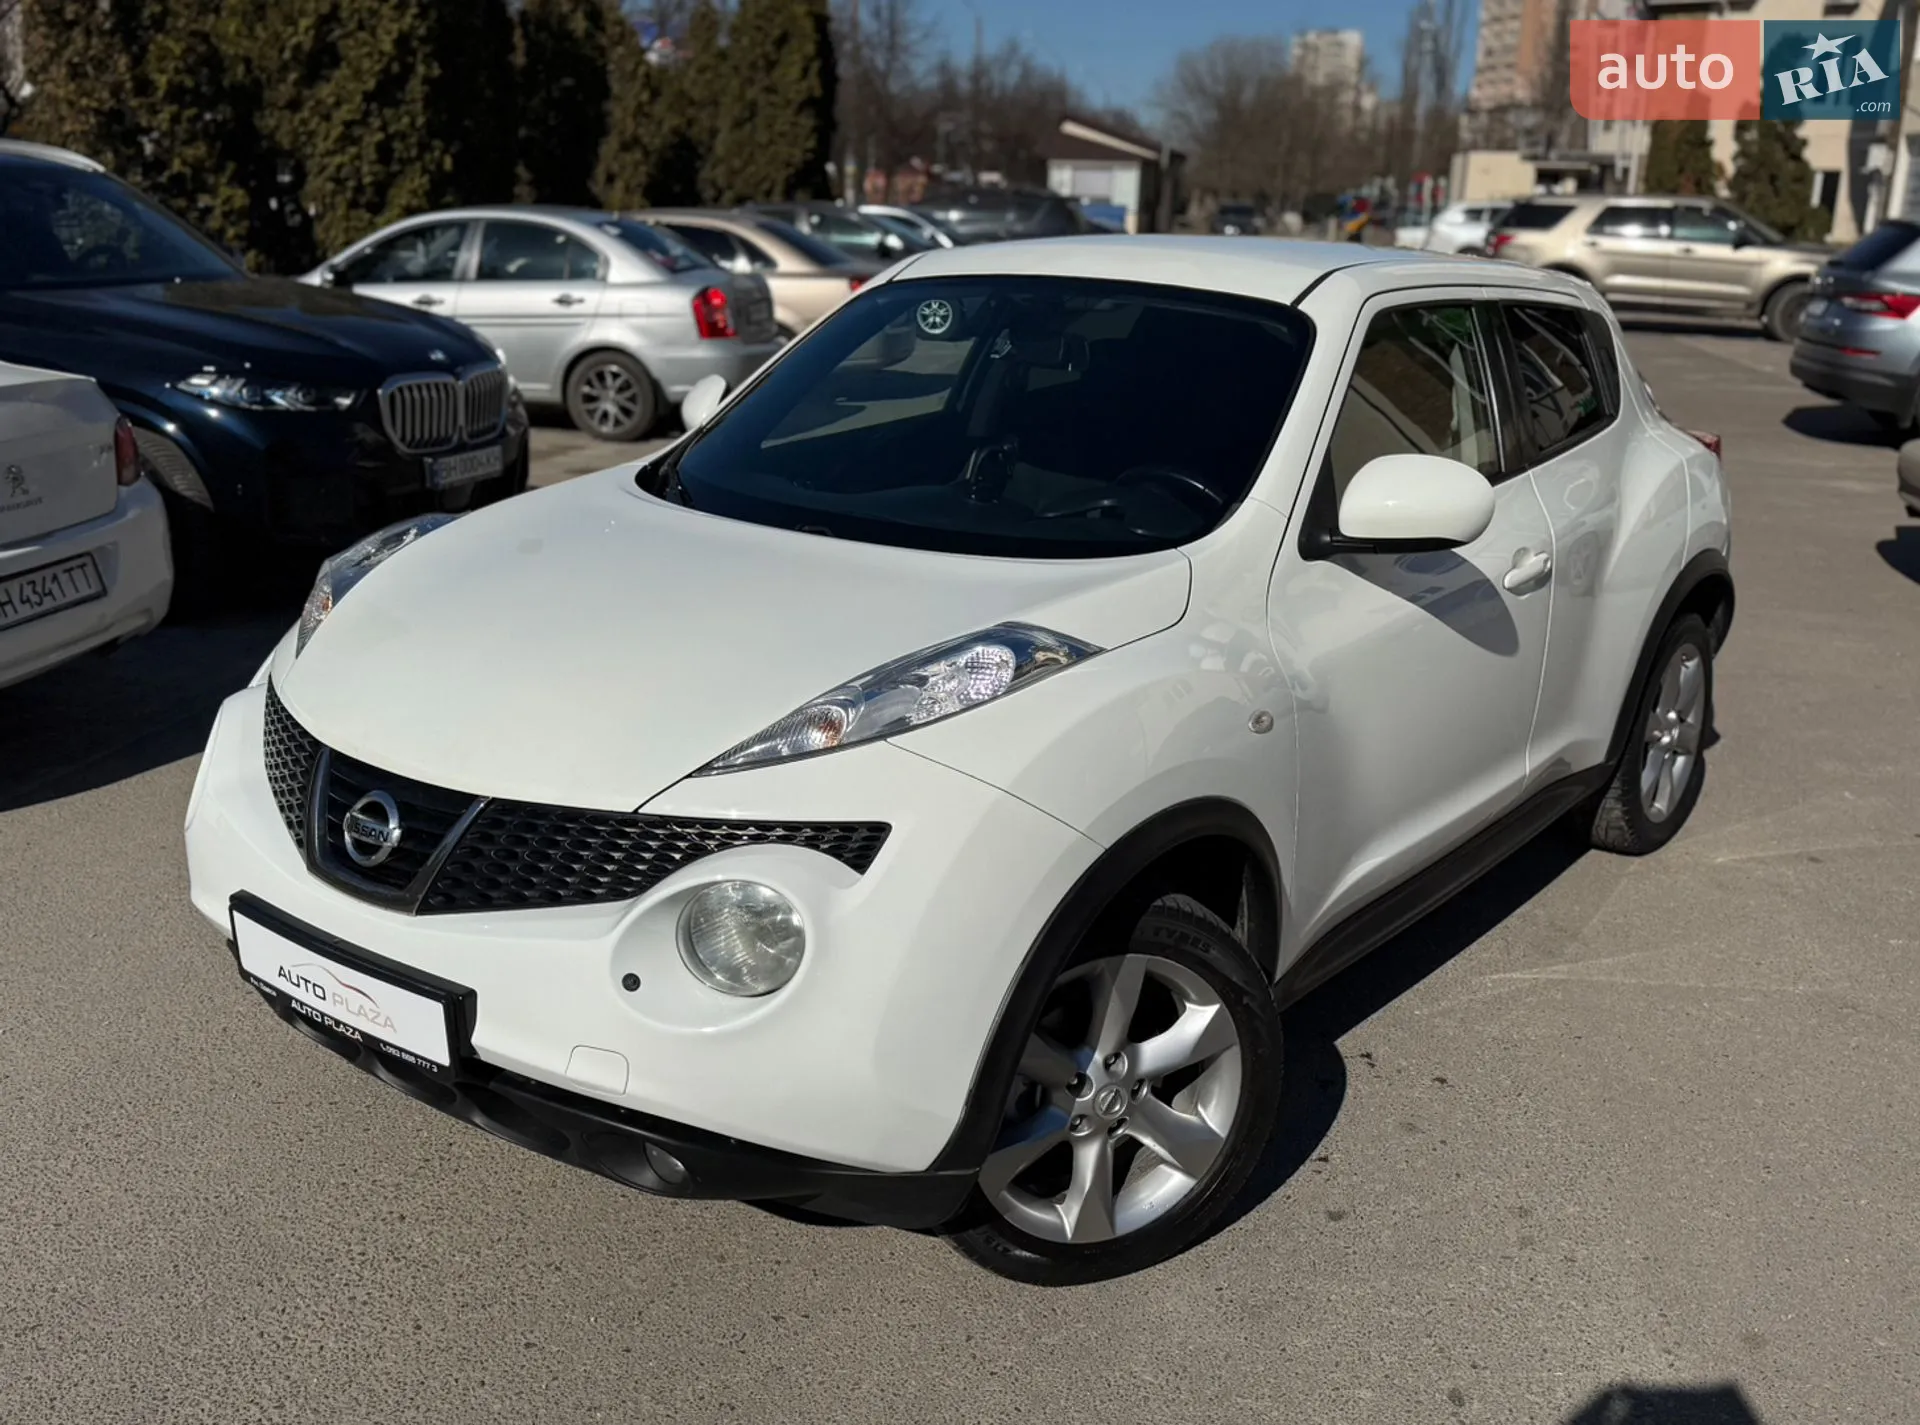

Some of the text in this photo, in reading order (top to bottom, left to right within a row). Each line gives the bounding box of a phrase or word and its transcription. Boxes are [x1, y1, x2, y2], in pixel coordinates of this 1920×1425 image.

[0, 587, 18, 618] H
[278, 965, 327, 1001] AUTO
[332, 992, 398, 1034] PLAZA
[291, 999, 364, 1042] AUTO PLAZA
